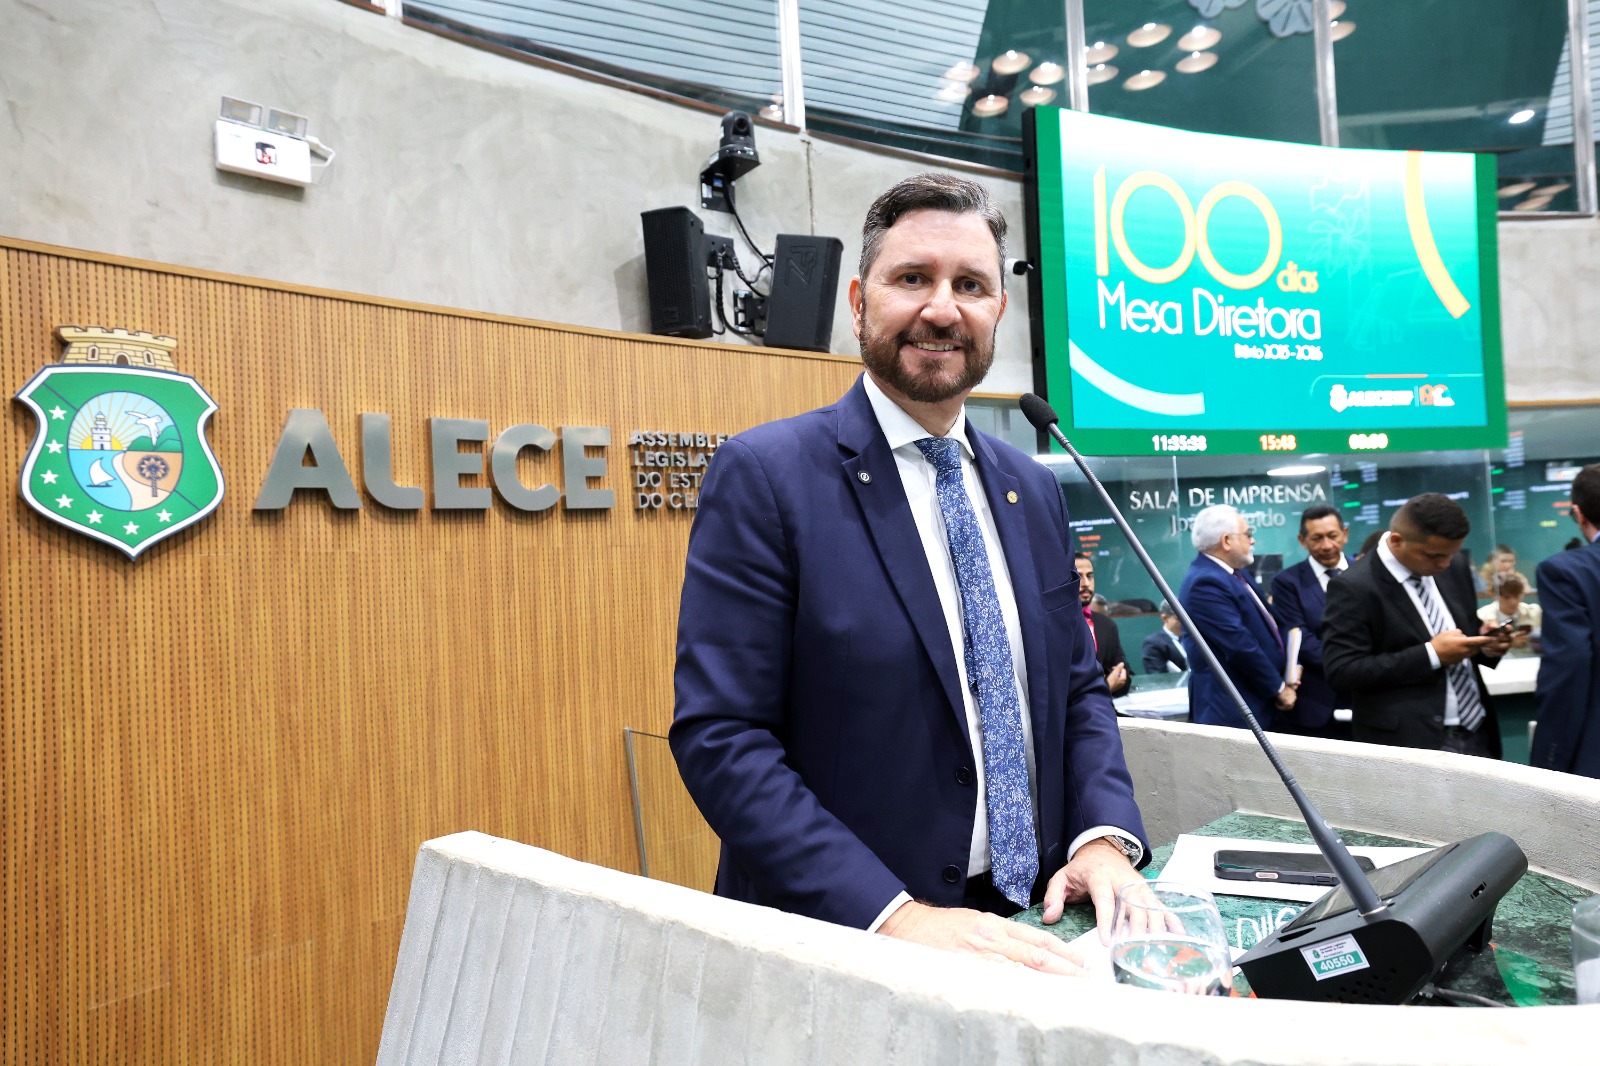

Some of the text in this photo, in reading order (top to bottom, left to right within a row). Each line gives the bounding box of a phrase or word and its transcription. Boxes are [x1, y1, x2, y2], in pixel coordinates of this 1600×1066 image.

[1093, 163, 1282, 290] 100
[1276, 260, 1319, 293] dias
[1097, 278, 1322, 340] Mesa Diretora
[628, 429, 734, 447] ASSEMBLE
[253, 407, 615, 511] ALECE
[636, 471, 704, 488] DO EST
[638, 492, 664, 508] DO
[1130, 483, 1327, 510] SALA DE IMPRENSA
[1320, 953, 1356, 971] 40550
